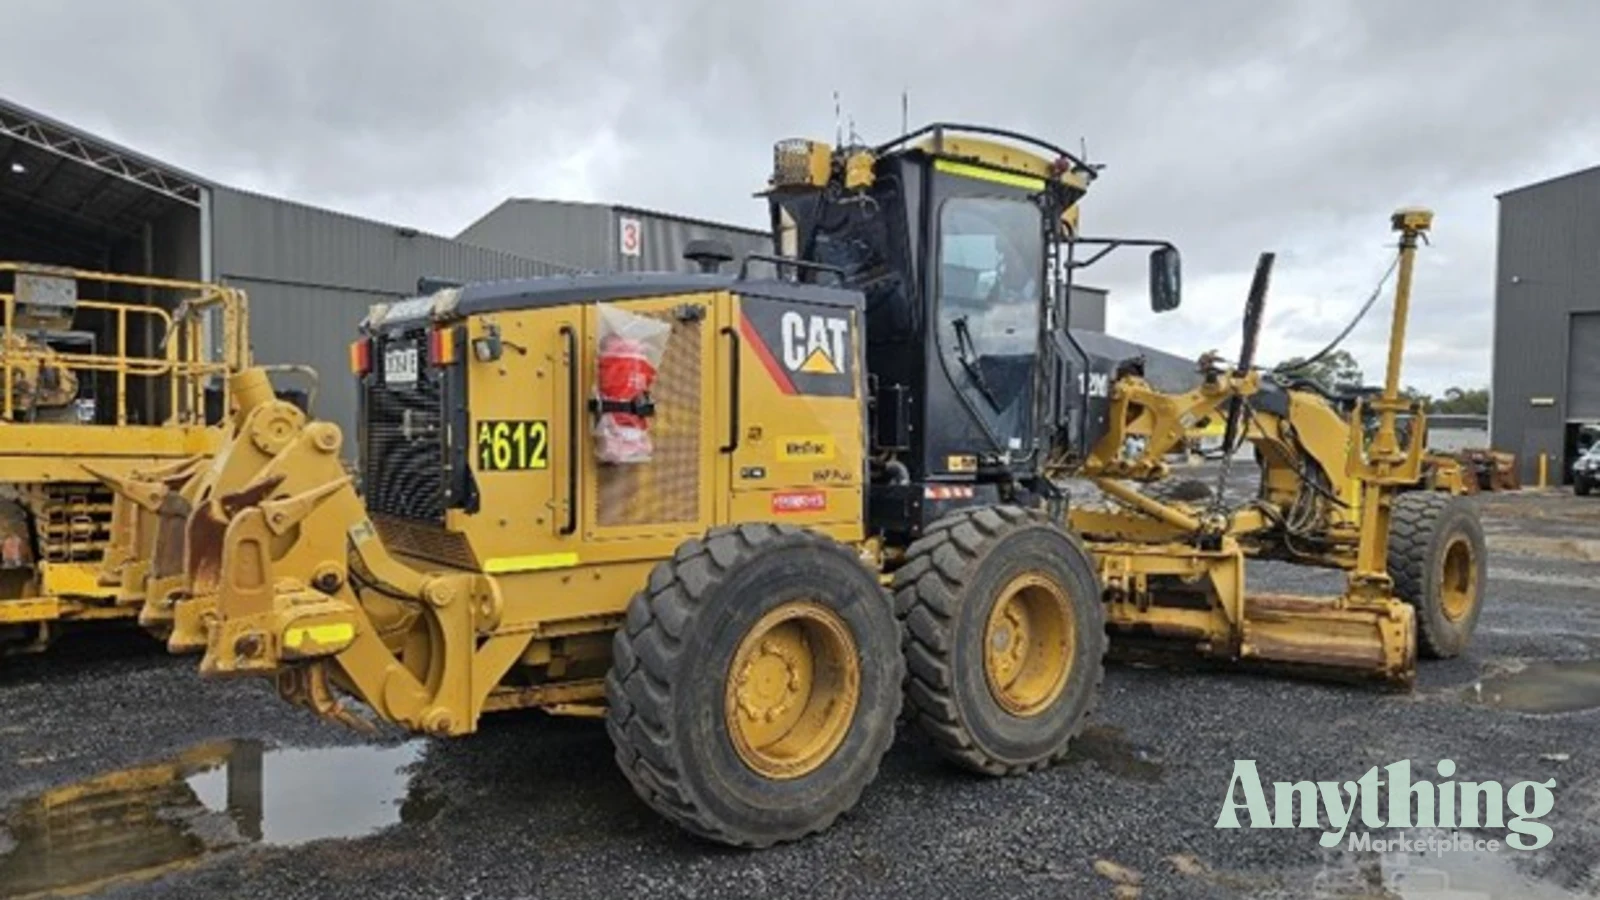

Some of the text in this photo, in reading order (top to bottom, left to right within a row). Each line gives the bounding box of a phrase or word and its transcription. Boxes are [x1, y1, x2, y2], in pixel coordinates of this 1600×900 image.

[625, 223, 637, 251] 3
[781, 310, 848, 374] CAT
[493, 421, 546, 471] 612
